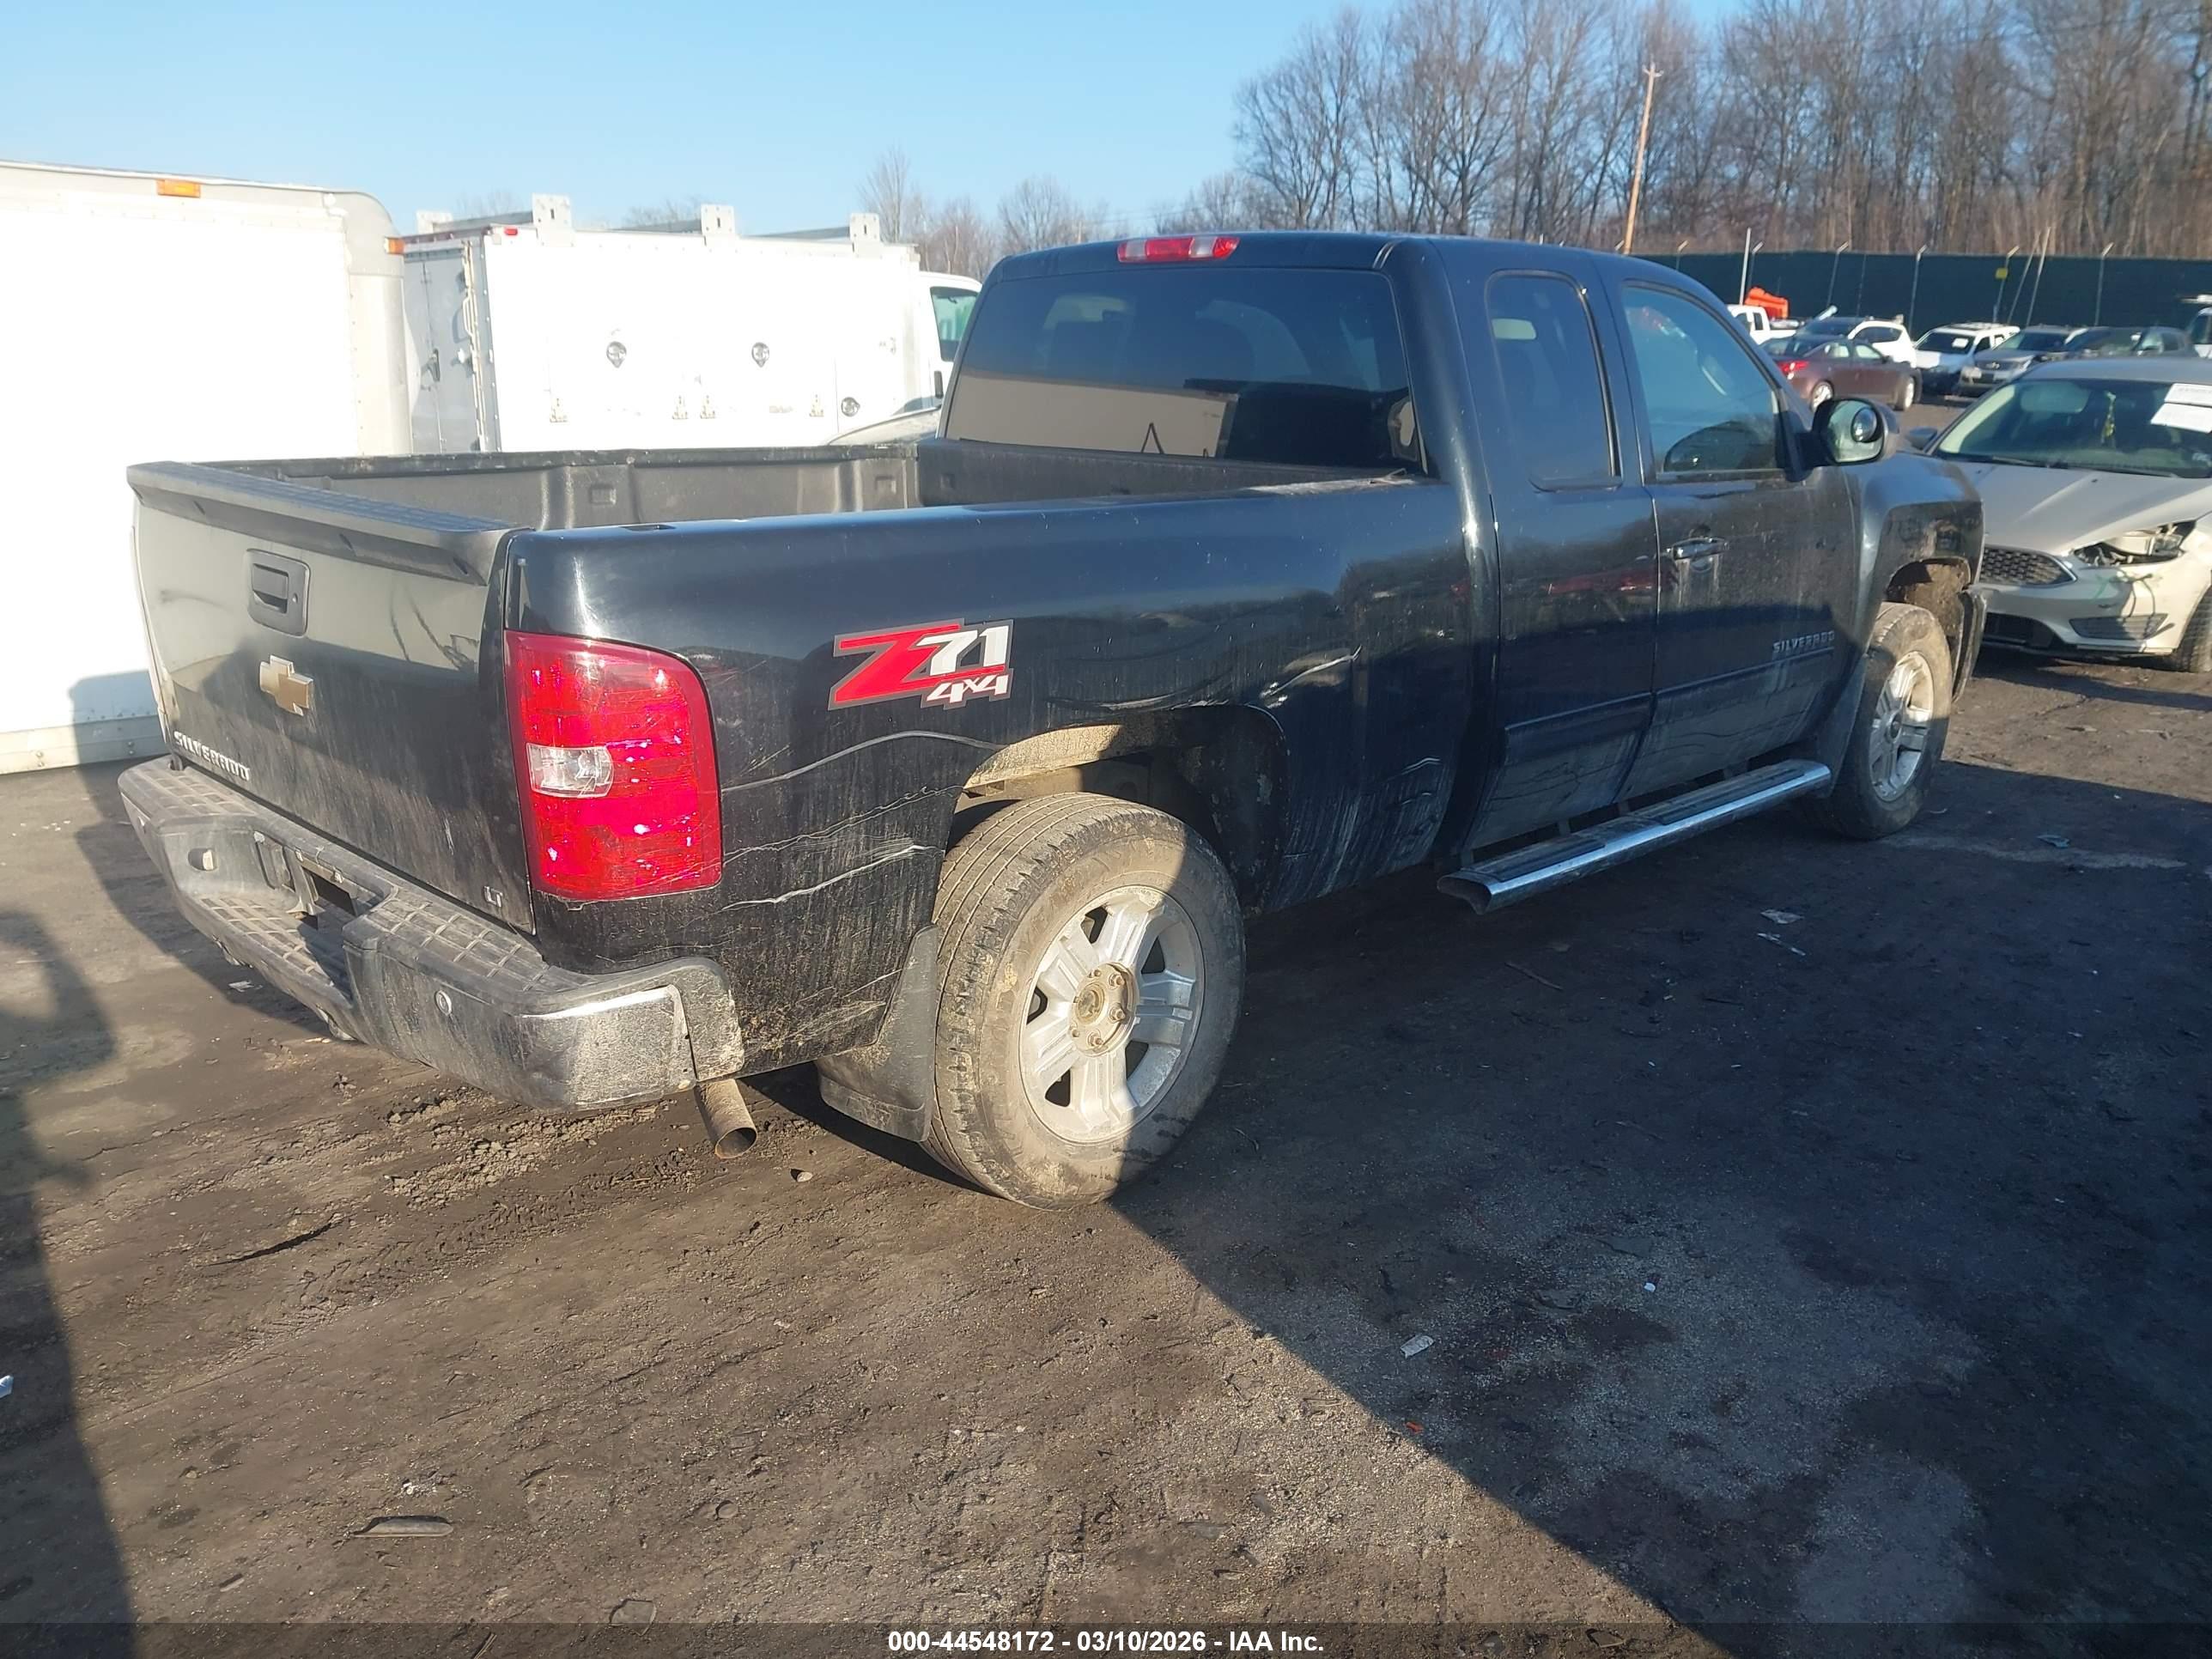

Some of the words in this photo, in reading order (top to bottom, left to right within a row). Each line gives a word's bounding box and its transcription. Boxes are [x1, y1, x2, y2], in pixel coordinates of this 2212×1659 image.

[1772, 629, 1835, 653] SILVERADO
[834, 623, 1010, 704] Z71
[173, 730, 251, 781] SILVERADO
[483, 885, 503, 908] LT
